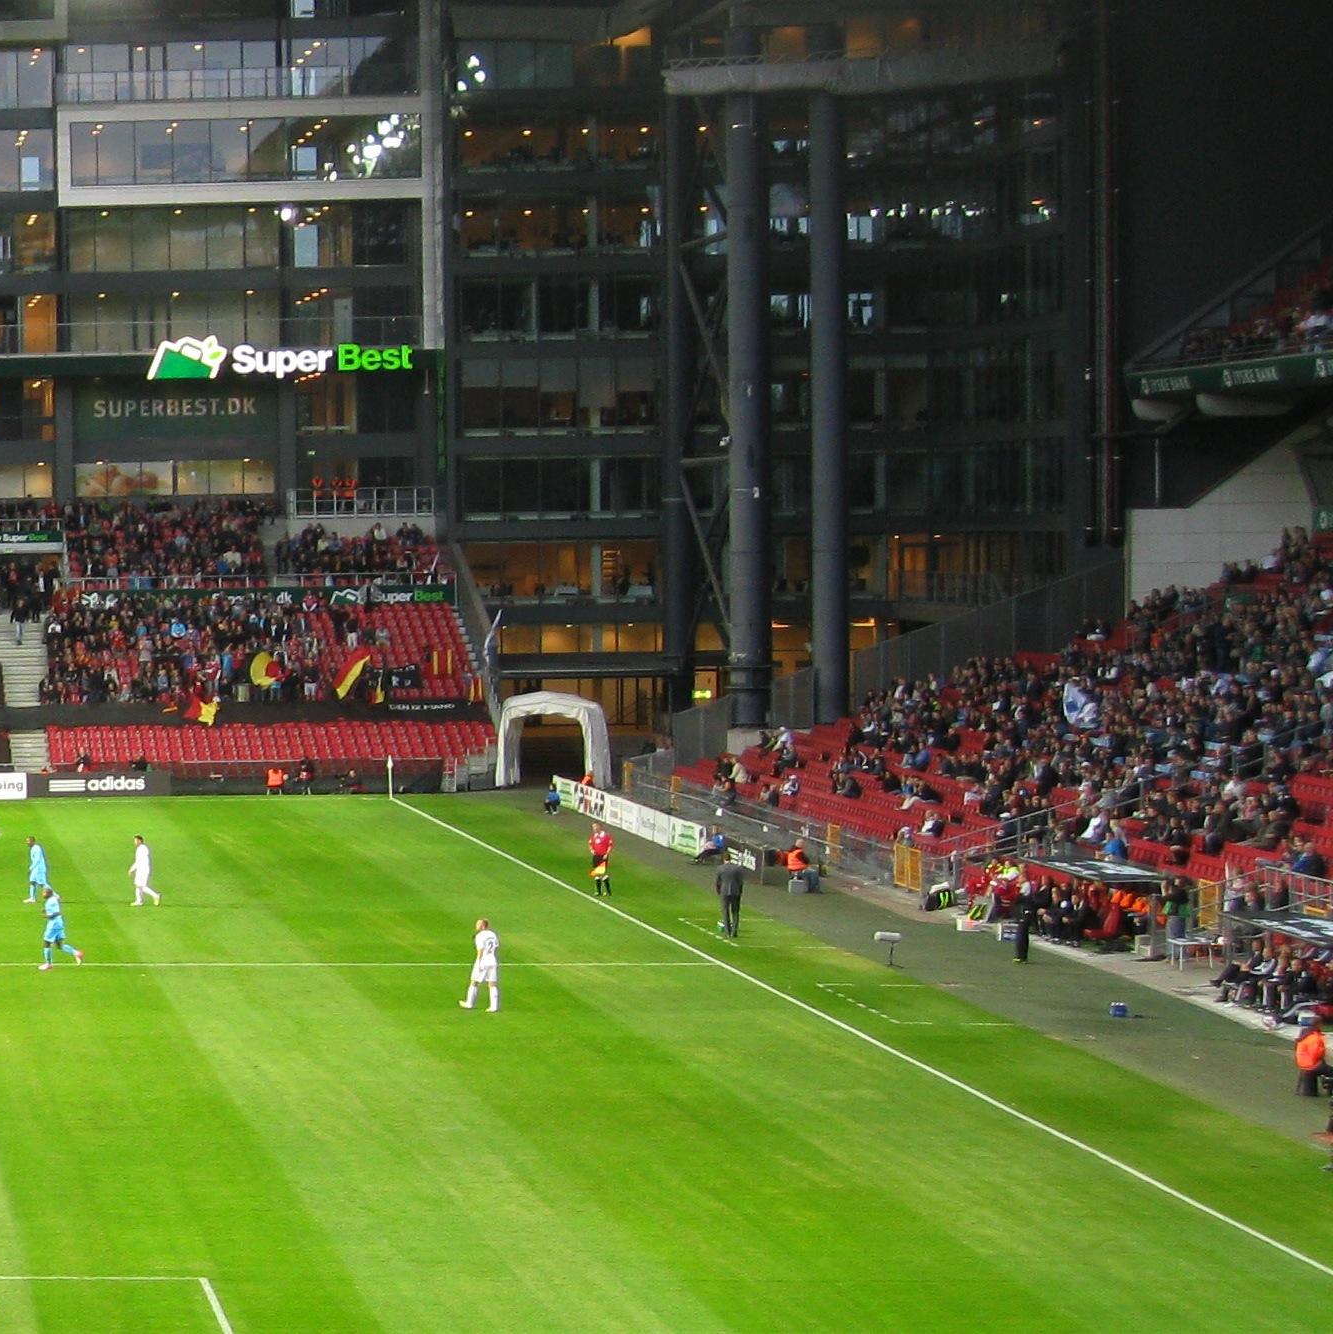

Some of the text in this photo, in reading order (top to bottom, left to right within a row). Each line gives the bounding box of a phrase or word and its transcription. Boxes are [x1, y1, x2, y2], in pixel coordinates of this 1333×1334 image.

[231, 343, 414, 379] Super Best
[92, 396, 258, 419] SUPERBEST.DK
[86, 775, 147, 792] adidas
